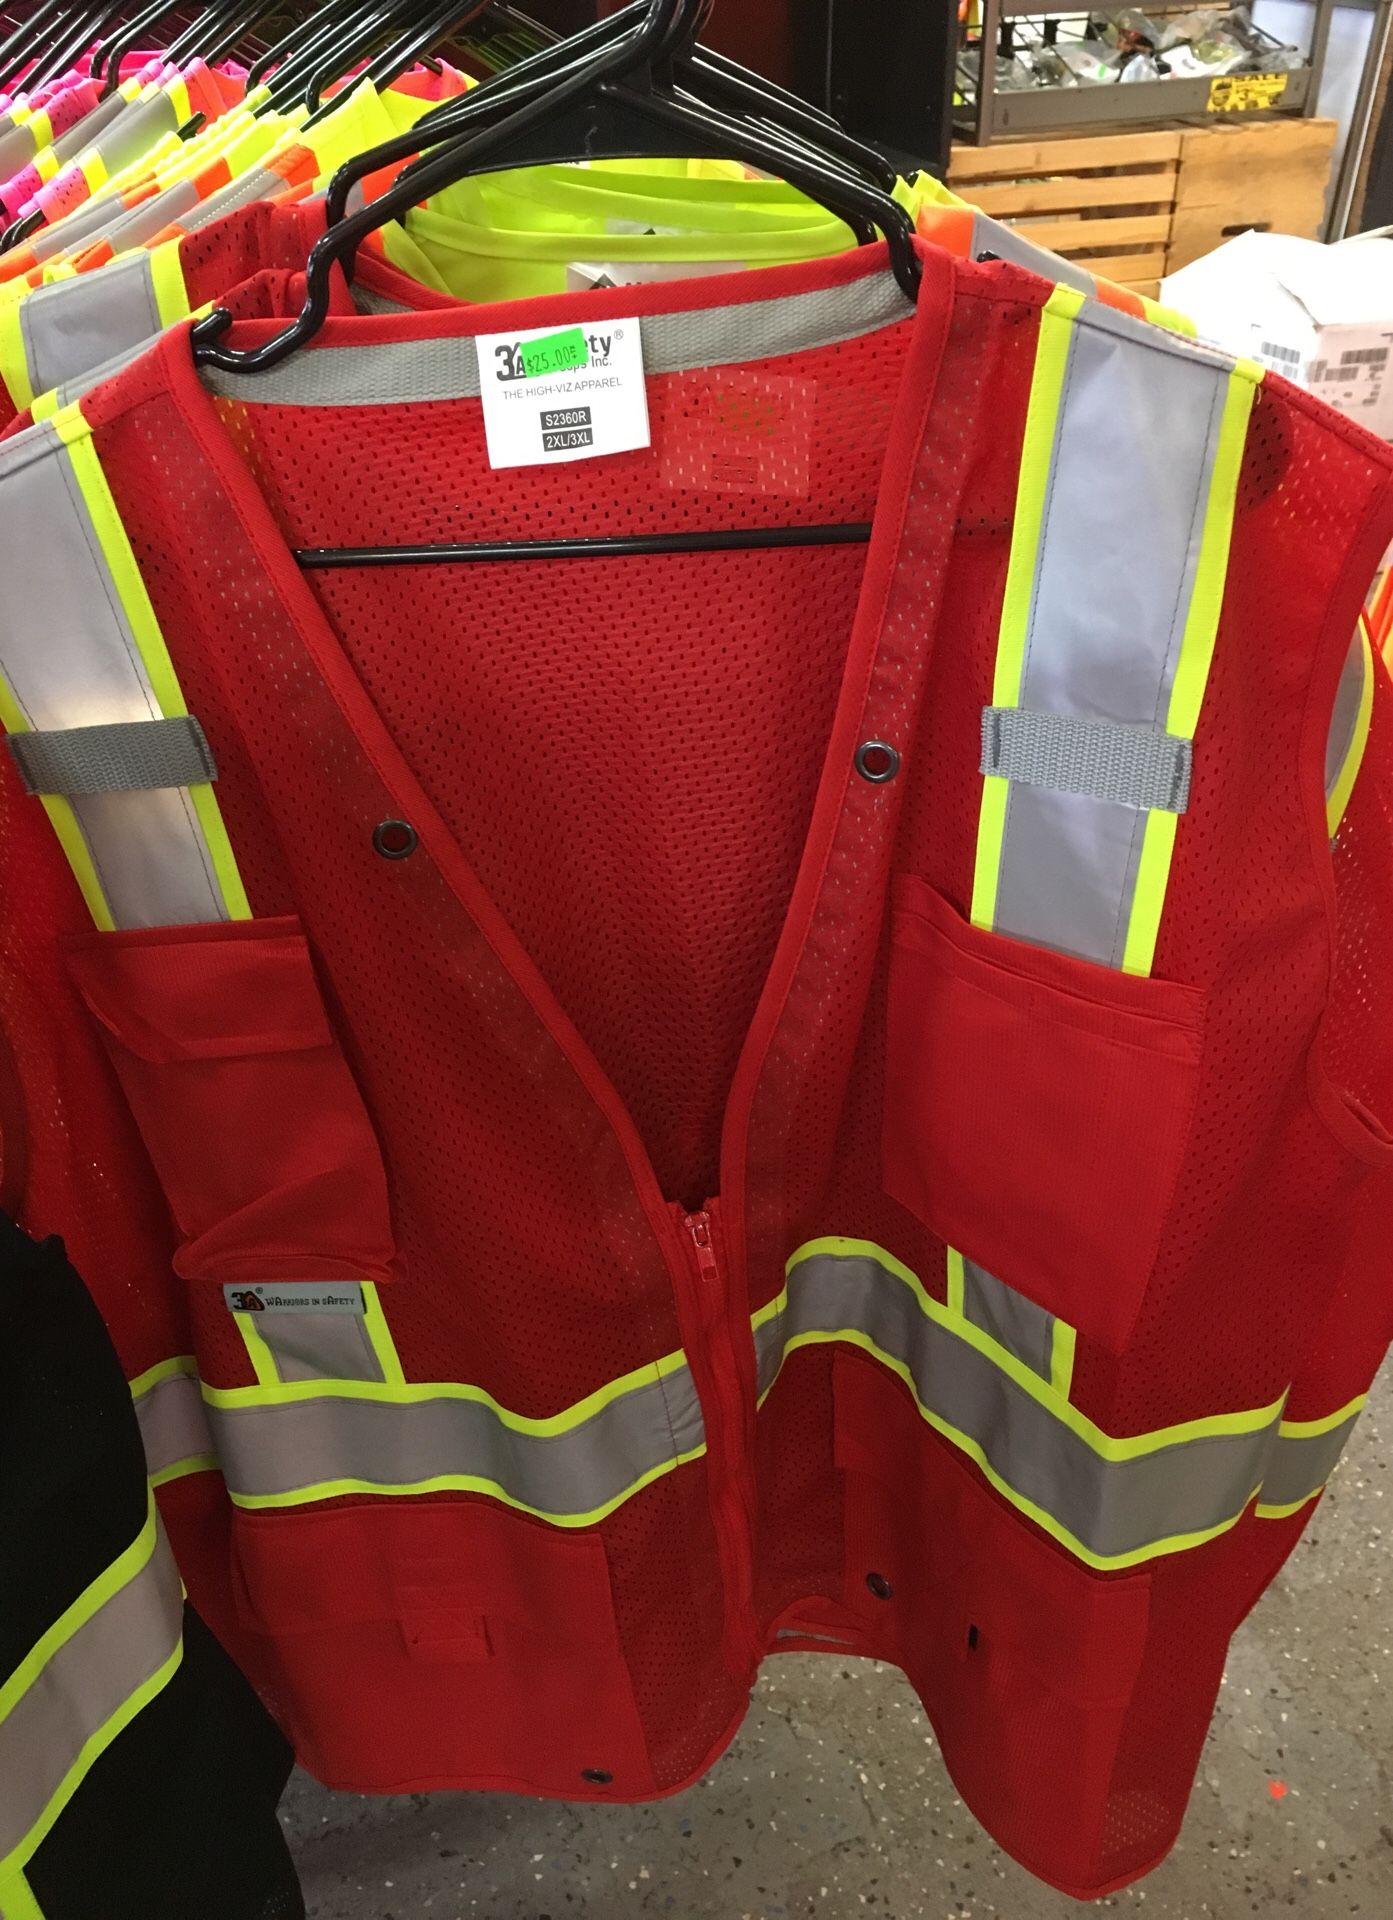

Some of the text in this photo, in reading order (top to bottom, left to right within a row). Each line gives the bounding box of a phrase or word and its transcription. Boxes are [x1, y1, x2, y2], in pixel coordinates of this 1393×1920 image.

[591, 355, 612, 368] Inc.
[503, 377, 623, 400] THE HIGH-VIZ APPAREL
[545, 410, 587, 427] S2360R
[546, 431, 591, 448] 2XL/3XL
[311, 1298, 320, 1306] IN
